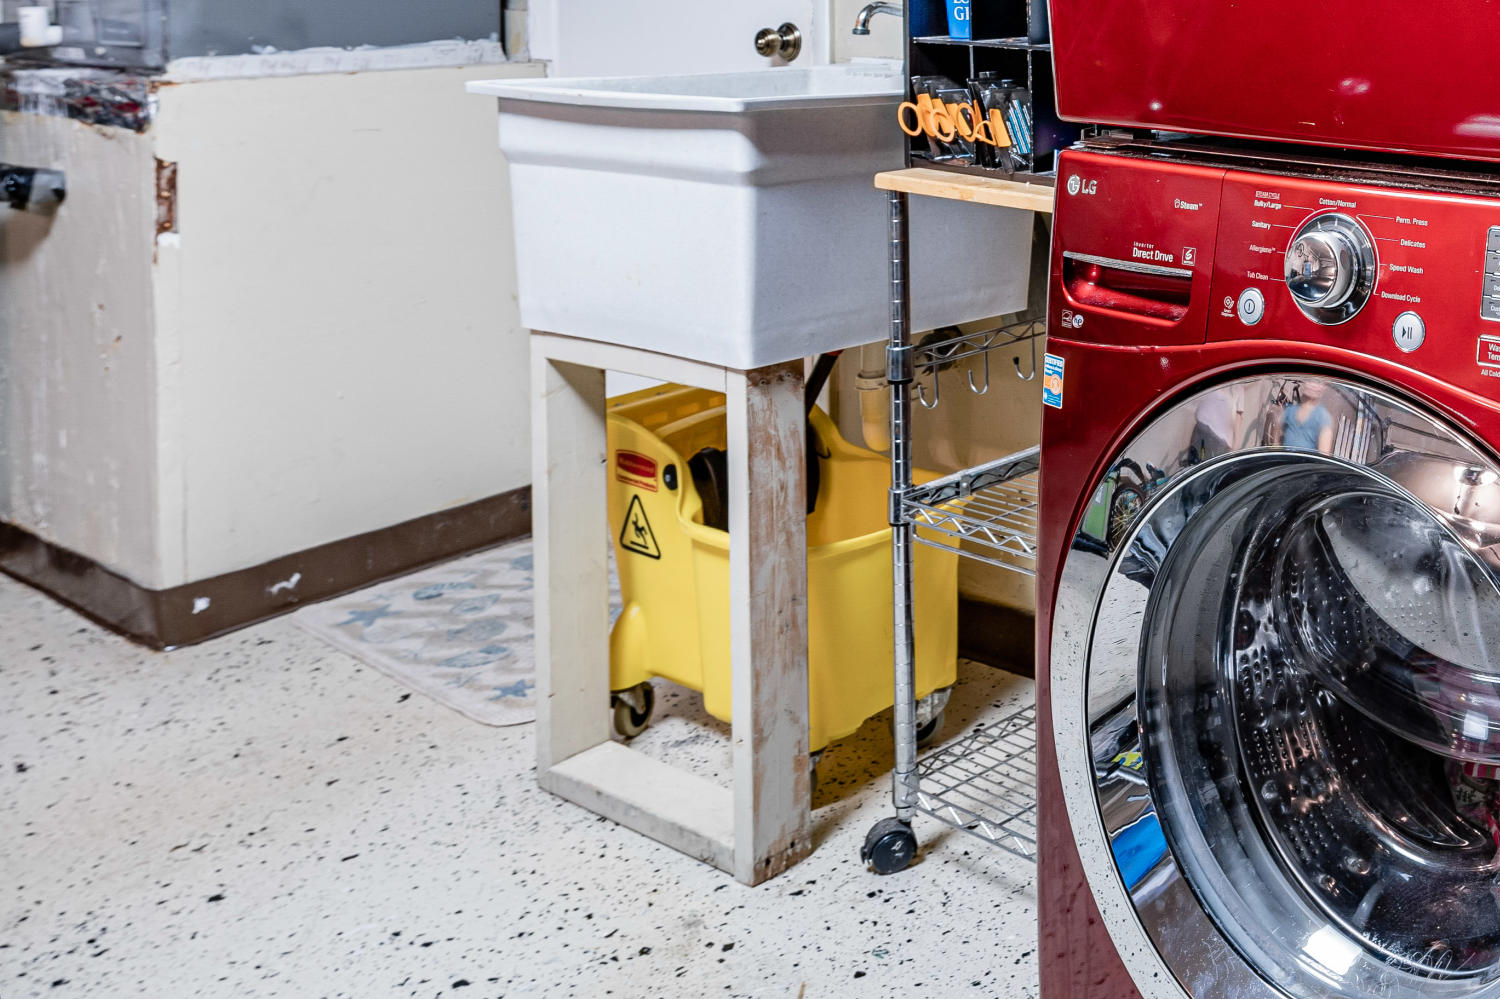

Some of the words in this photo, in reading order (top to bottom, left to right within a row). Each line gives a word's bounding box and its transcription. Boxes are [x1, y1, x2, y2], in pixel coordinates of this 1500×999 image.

[1081, 179, 1098, 195] LG
[1319, 197, 1357, 209] Cotton/Normal
[1251, 220, 1271, 230] Sanitary
[1395, 216, 1411, 226] Perm.
[1413, 217, 1428, 227] Press
[1400, 238, 1427, 249] Delicates
[1133, 248, 1154, 260] Direct
[1155, 250, 1174, 263] Drive
[1389, 263, 1403, 273] Speed
[1404, 265, 1424, 275] Wash
[1255, 272, 1268, 281] Clean
[1381, 290, 1406, 301] Download
[1406, 293, 1421, 304] Cycle
[1481, 368, 1489, 377] All
[1489, 370, 1500, 378] Cold
